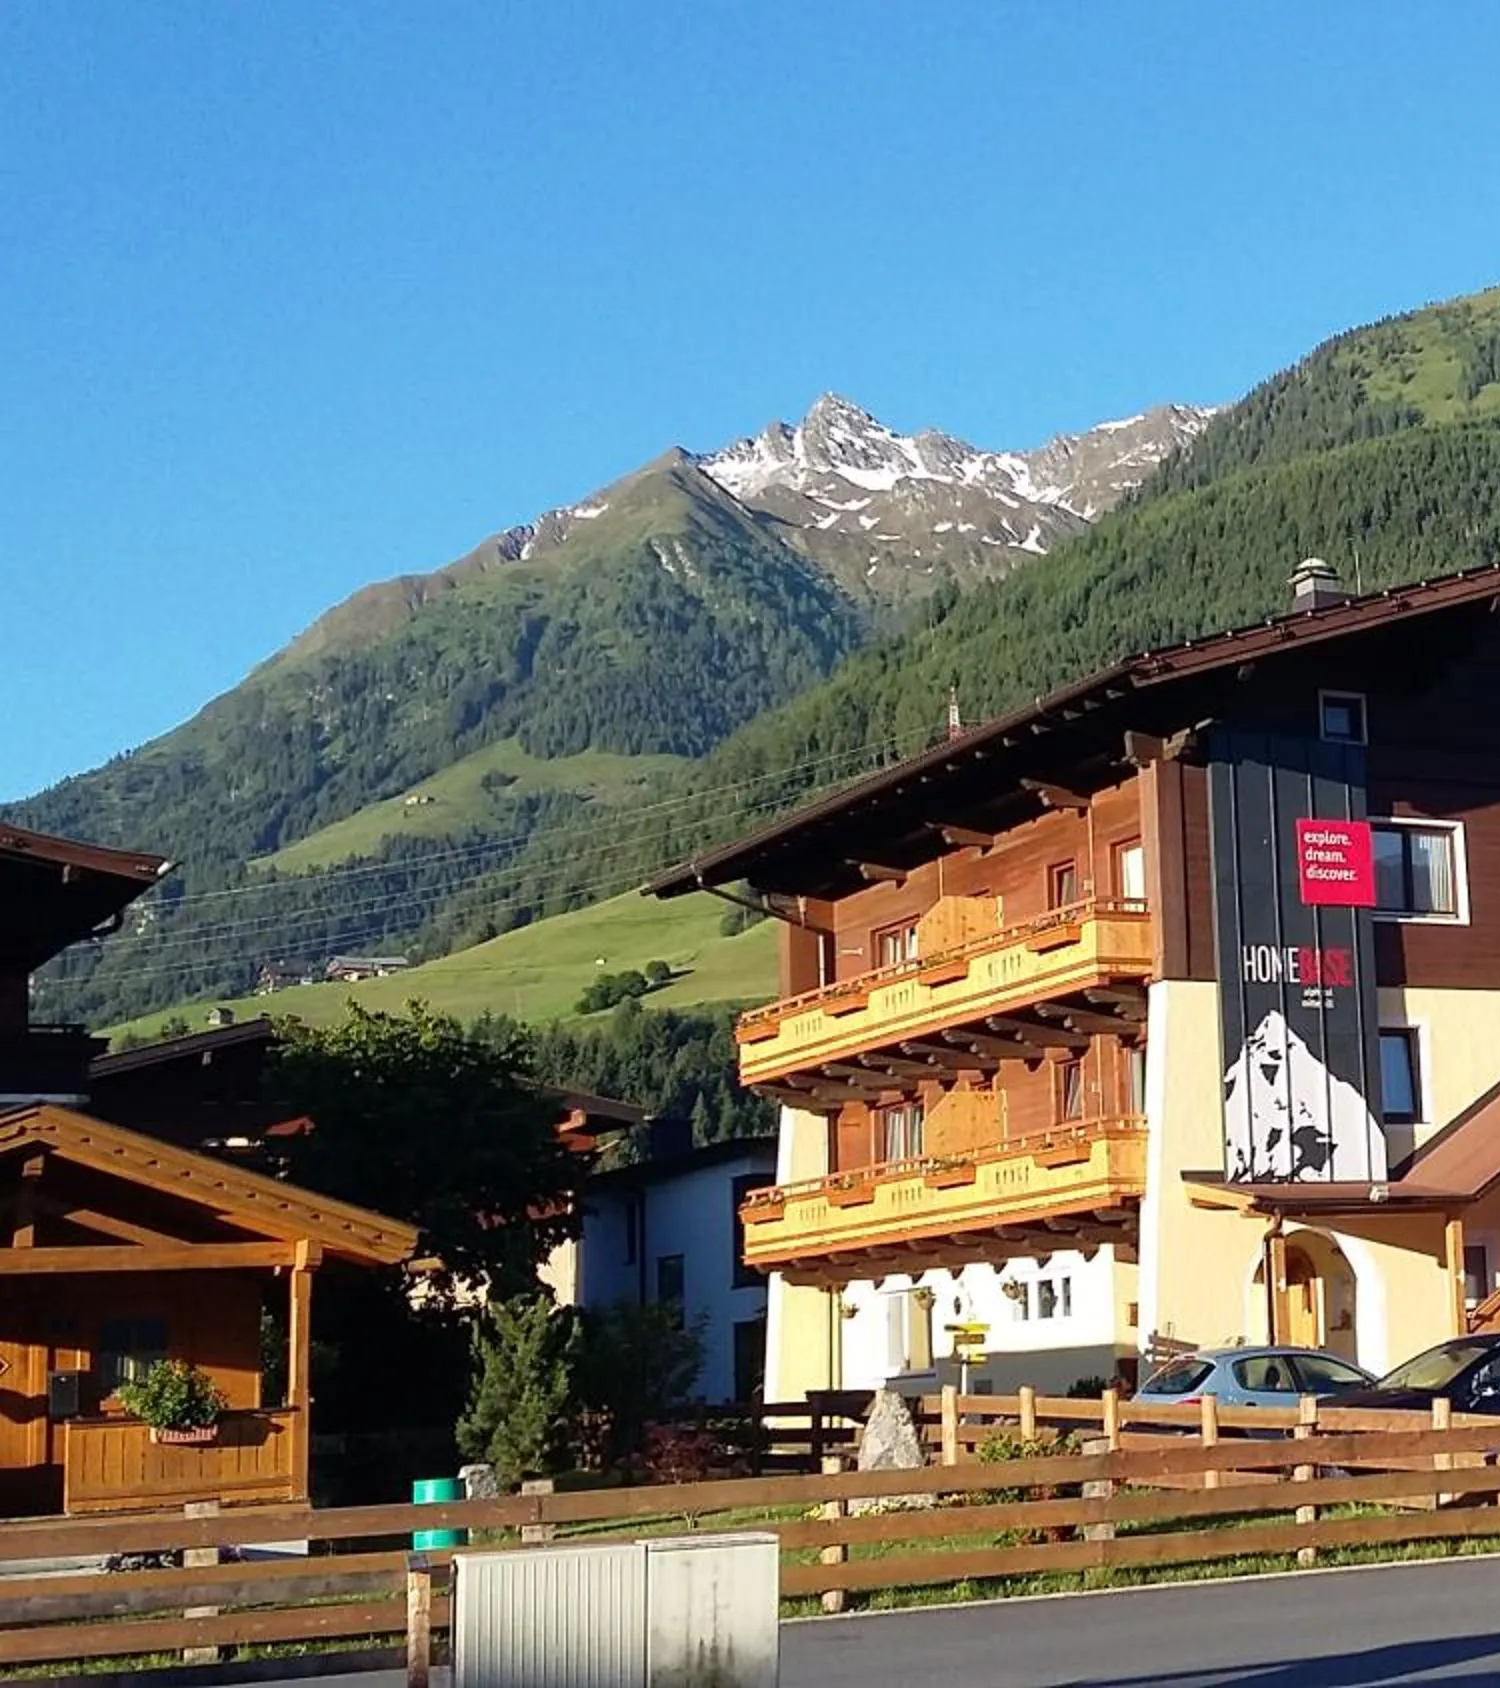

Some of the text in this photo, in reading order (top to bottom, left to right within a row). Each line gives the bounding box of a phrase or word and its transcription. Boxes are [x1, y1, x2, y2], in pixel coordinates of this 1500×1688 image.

[1303, 830, 1352, 847] explore.
[1305, 846, 1346, 862] dream.
[1306, 864, 1358, 880] discover.
